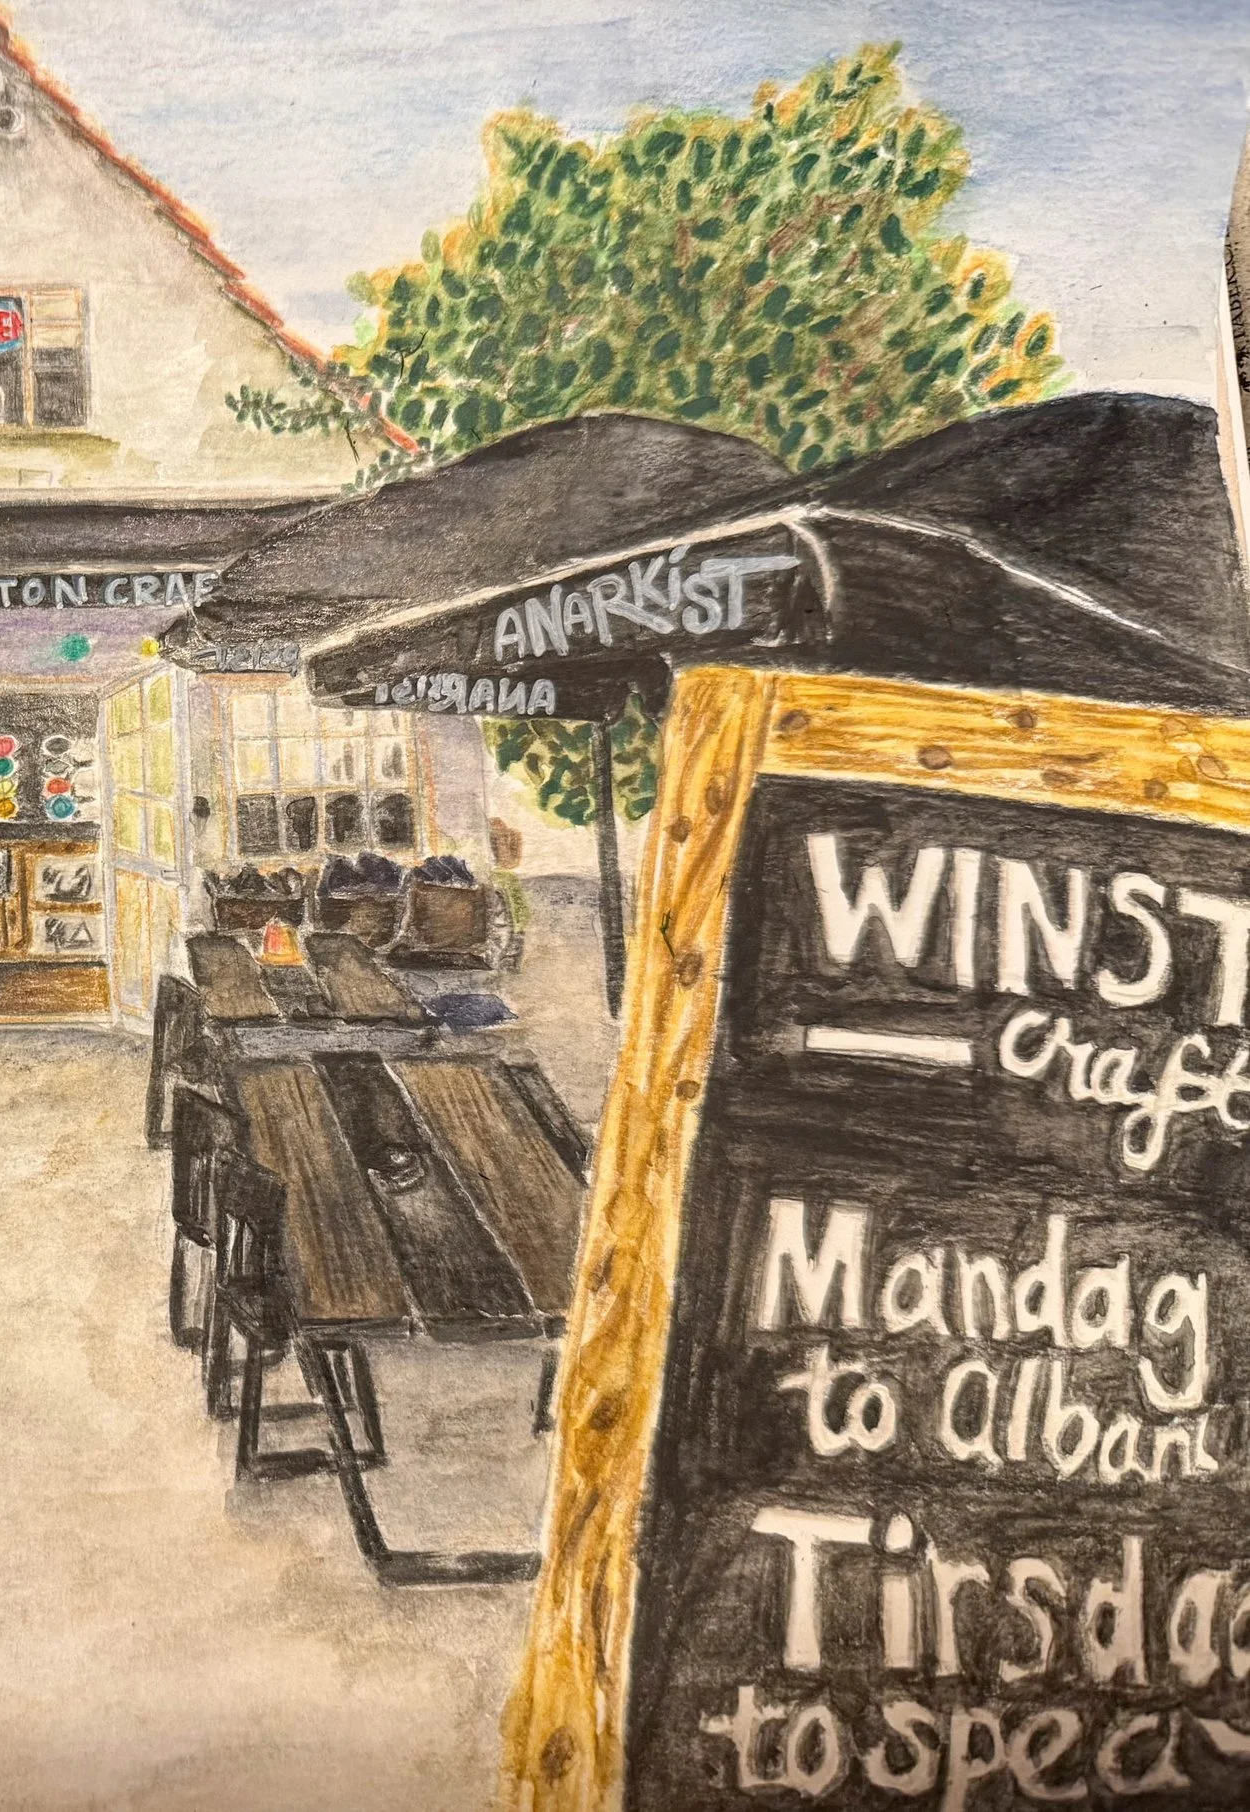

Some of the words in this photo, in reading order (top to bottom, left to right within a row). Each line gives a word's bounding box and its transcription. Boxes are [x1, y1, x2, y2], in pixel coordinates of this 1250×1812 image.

[806, 833, 1250, 1027] WINST
[757, 1199, 1208, 1411] Mandag
[778, 1343, 897, 1457] to
